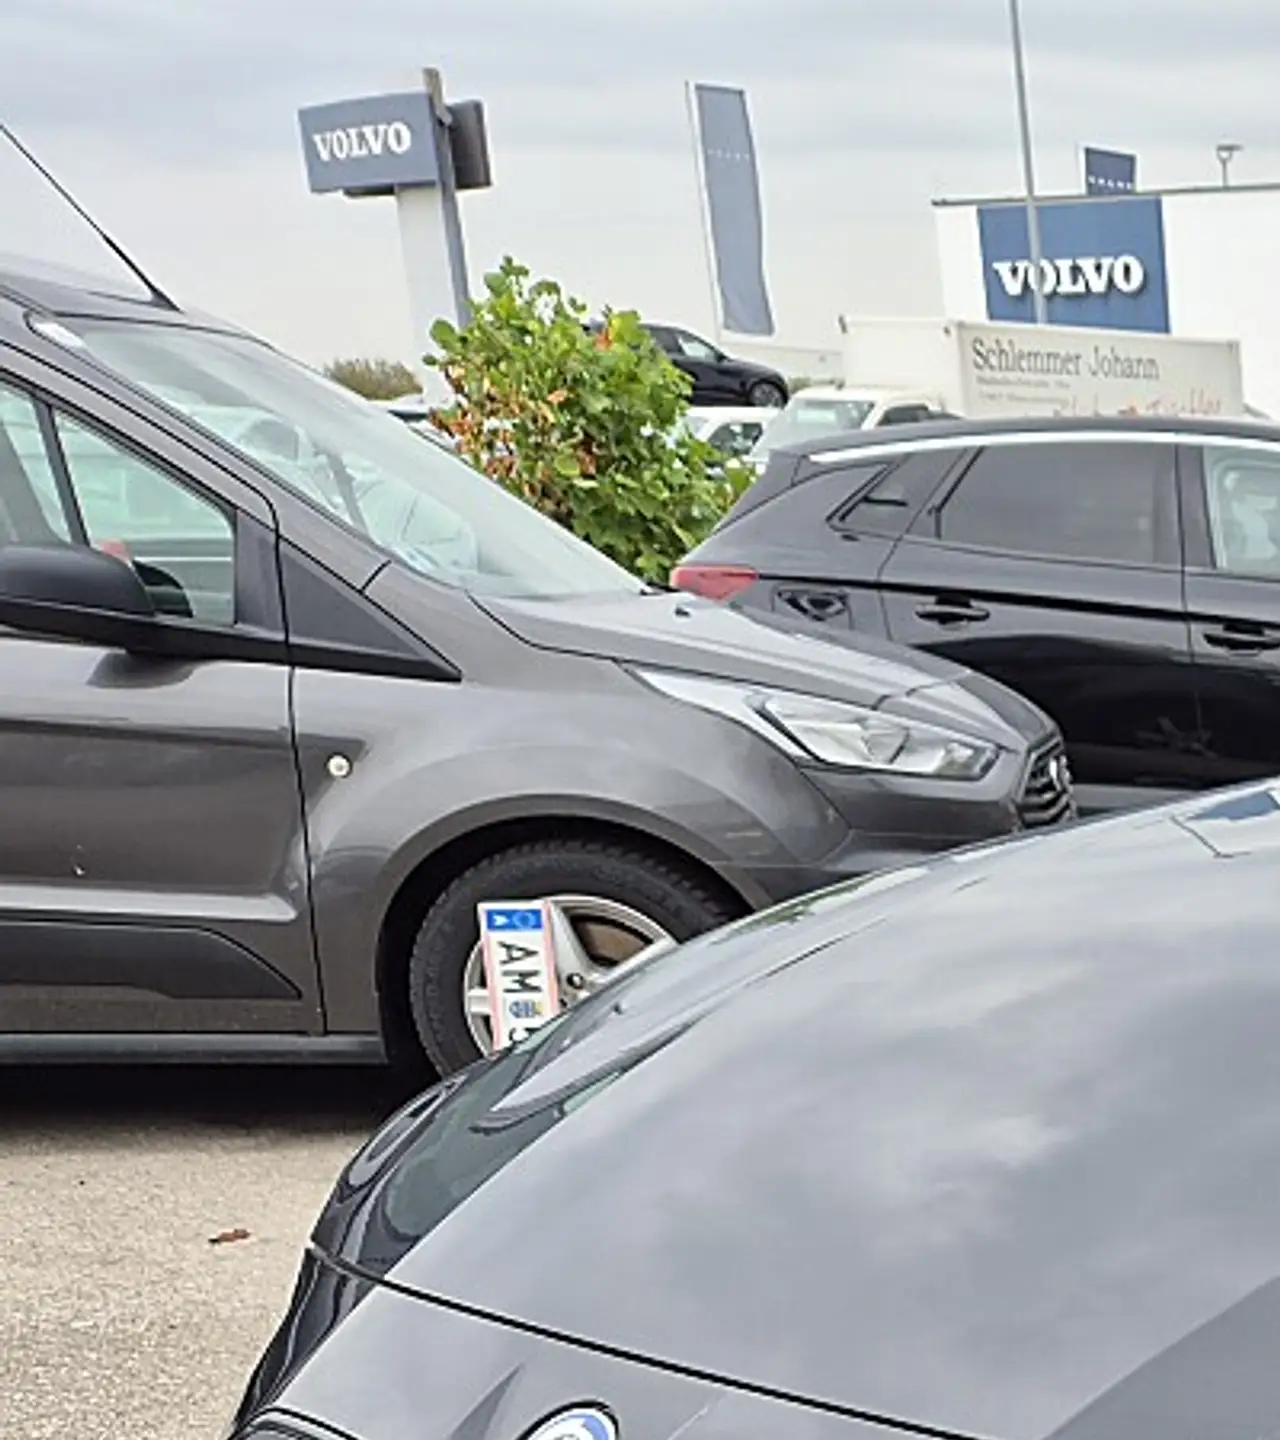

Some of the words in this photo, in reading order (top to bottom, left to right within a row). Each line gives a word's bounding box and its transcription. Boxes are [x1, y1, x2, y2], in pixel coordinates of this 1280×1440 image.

[313, 122, 411, 161] VOLVO
[992, 254, 1144, 296] VOLVO
[972, 336, 1082, 376] Schlemmer
[1089, 346, 1160, 380] Johann
[497, 941, 542, 993] AM
